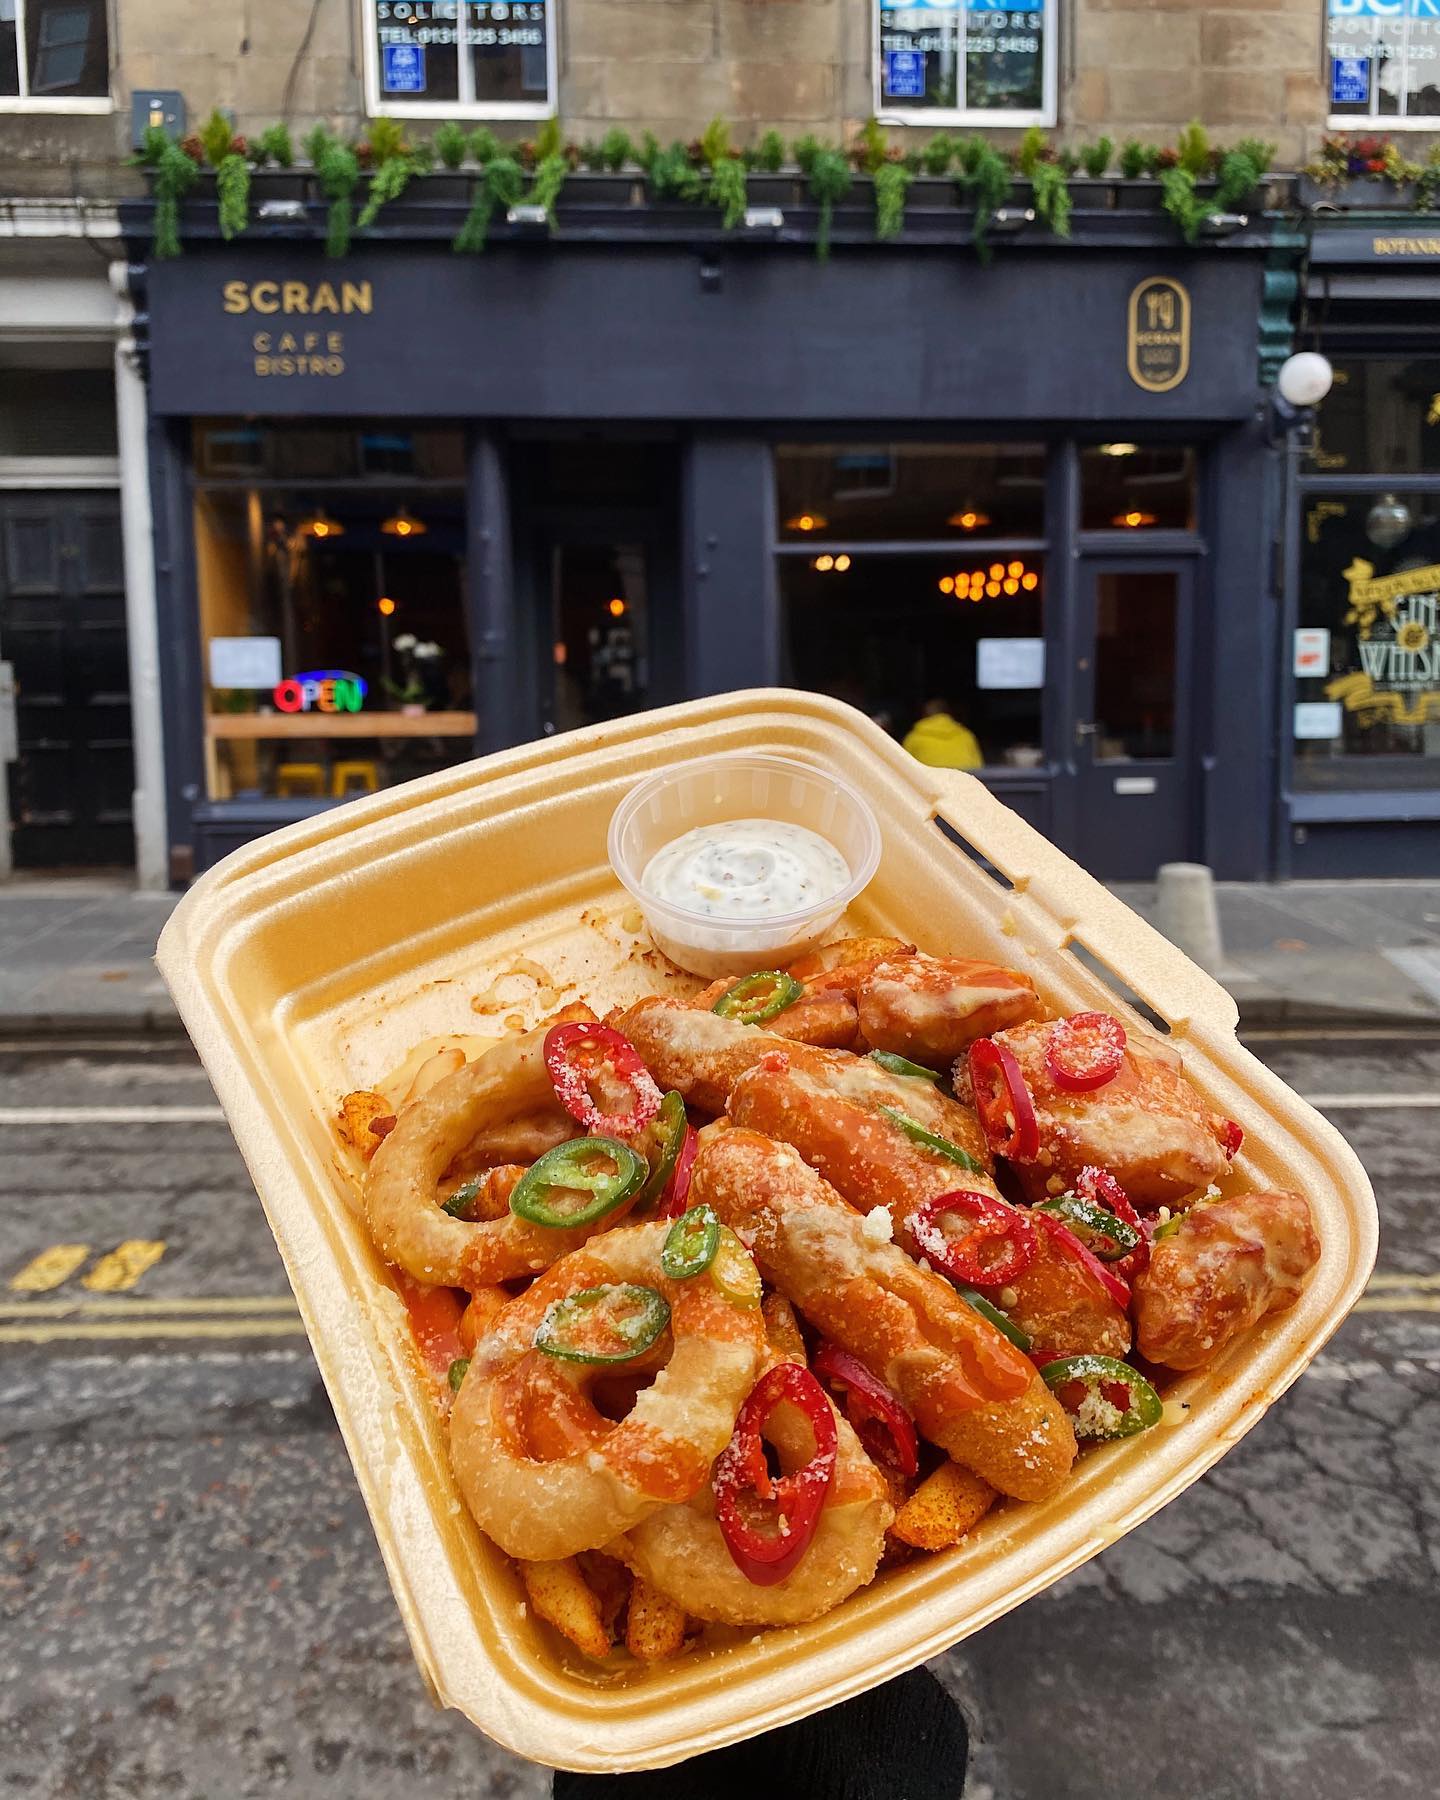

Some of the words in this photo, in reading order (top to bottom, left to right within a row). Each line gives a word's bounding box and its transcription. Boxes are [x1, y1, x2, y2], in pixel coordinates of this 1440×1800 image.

[377, 3, 544, 20] SOLICITORS
[223, 280, 372, 314] SCRAN
[253, 331, 344, 352] CAFE
[254, 355, 345, 376] BISTRO
[273, 679, 363, 712] OPEN
